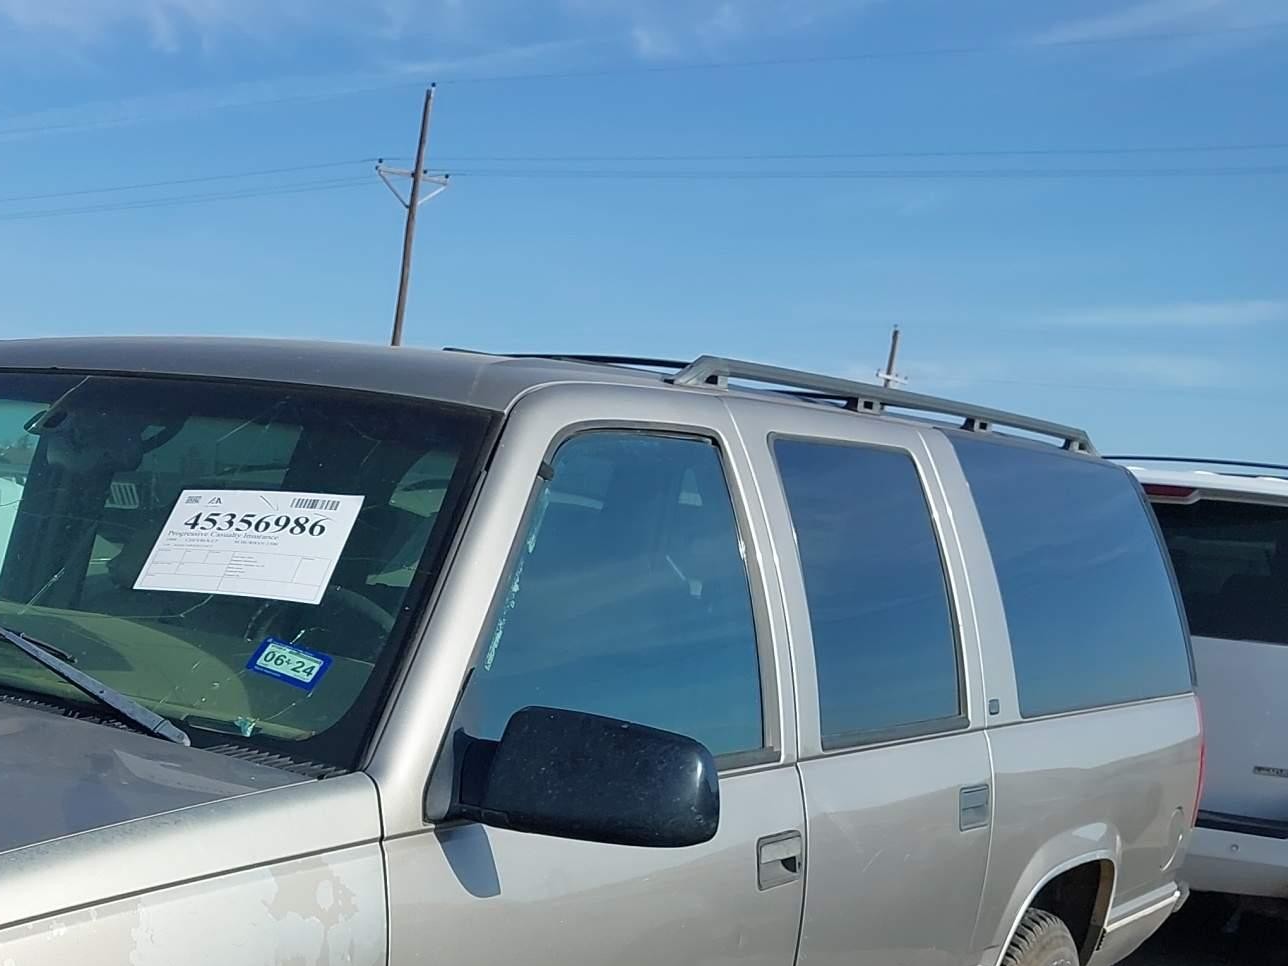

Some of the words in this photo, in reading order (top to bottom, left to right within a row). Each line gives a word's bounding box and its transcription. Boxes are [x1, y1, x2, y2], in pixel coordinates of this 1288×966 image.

[167, 530, 208, 539] Progressive
[210, 531, 242, 540] Casualty
[243, 533, 280, 541] Insurance
[183, 512, 332, 537] 45356986
[263, 651, 288, 667] 06
[290, 661, 316, 677] 24
